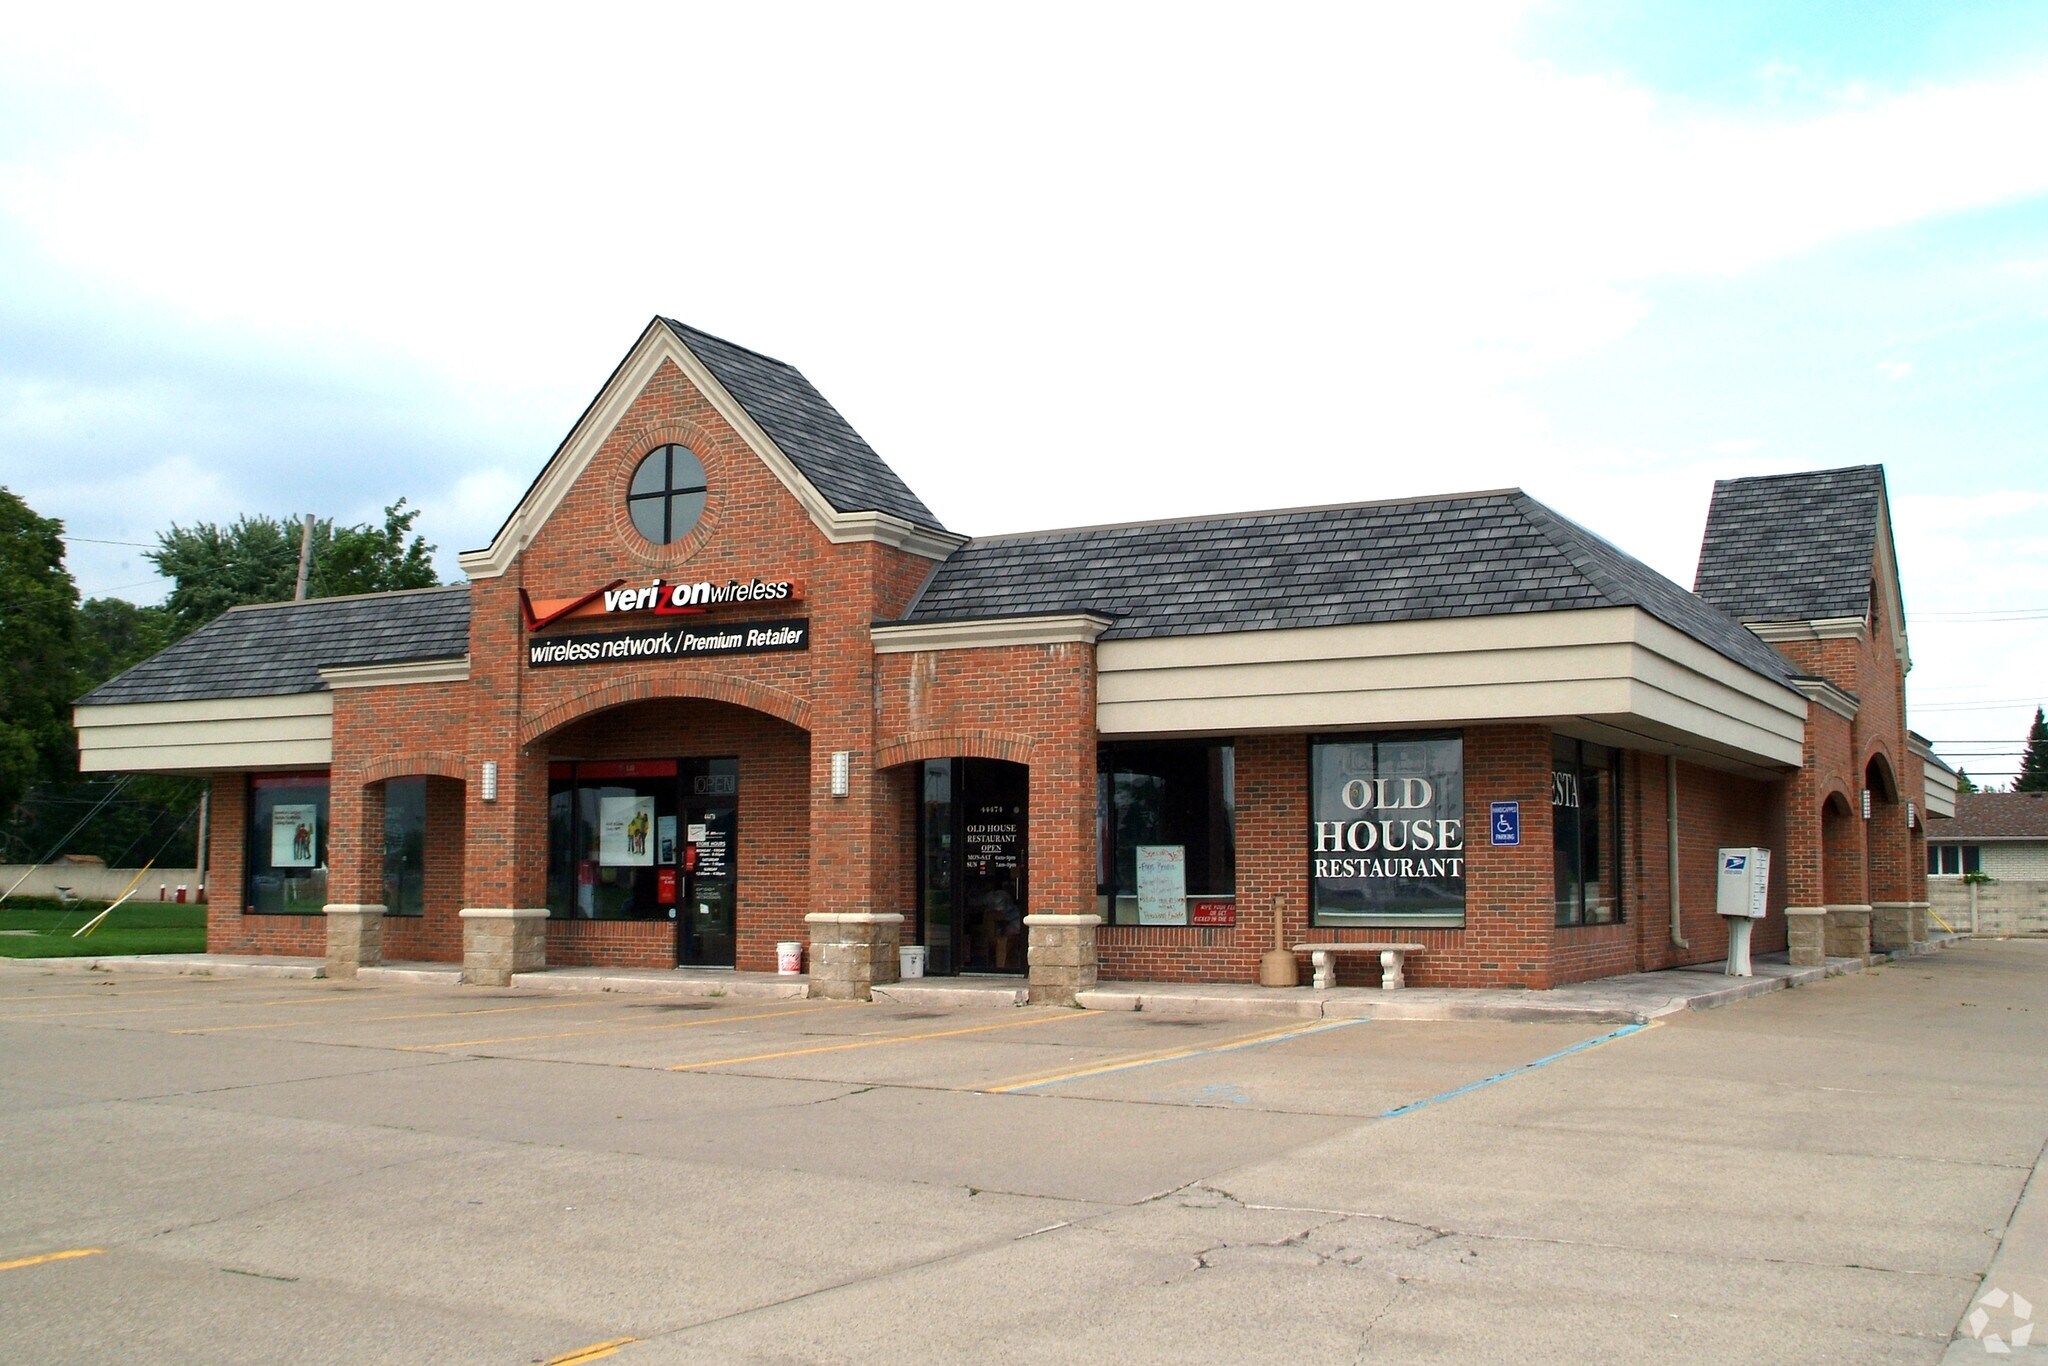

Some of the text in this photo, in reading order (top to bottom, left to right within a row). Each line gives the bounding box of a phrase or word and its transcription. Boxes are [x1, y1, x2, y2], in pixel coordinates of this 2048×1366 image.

[531, 639, 600, 663] wireless
[601, 632, 674, 658] network
[682, 631, 742, 651] Premium
[746, 627, 803, 647] Retailer
[696, 777, 733, 792] OPEN
[1341, 777, 1433, 810] OLD
[967, 824, 1017, 832] OLD HOUSE
[1314, 819, 1463, 852] HOUSE
[967, 834, 1017, 842] RESTAURANT
[981, 844, 1002, 853] OPEN
[1314, 858, 1463, 878] RESTAURANT
